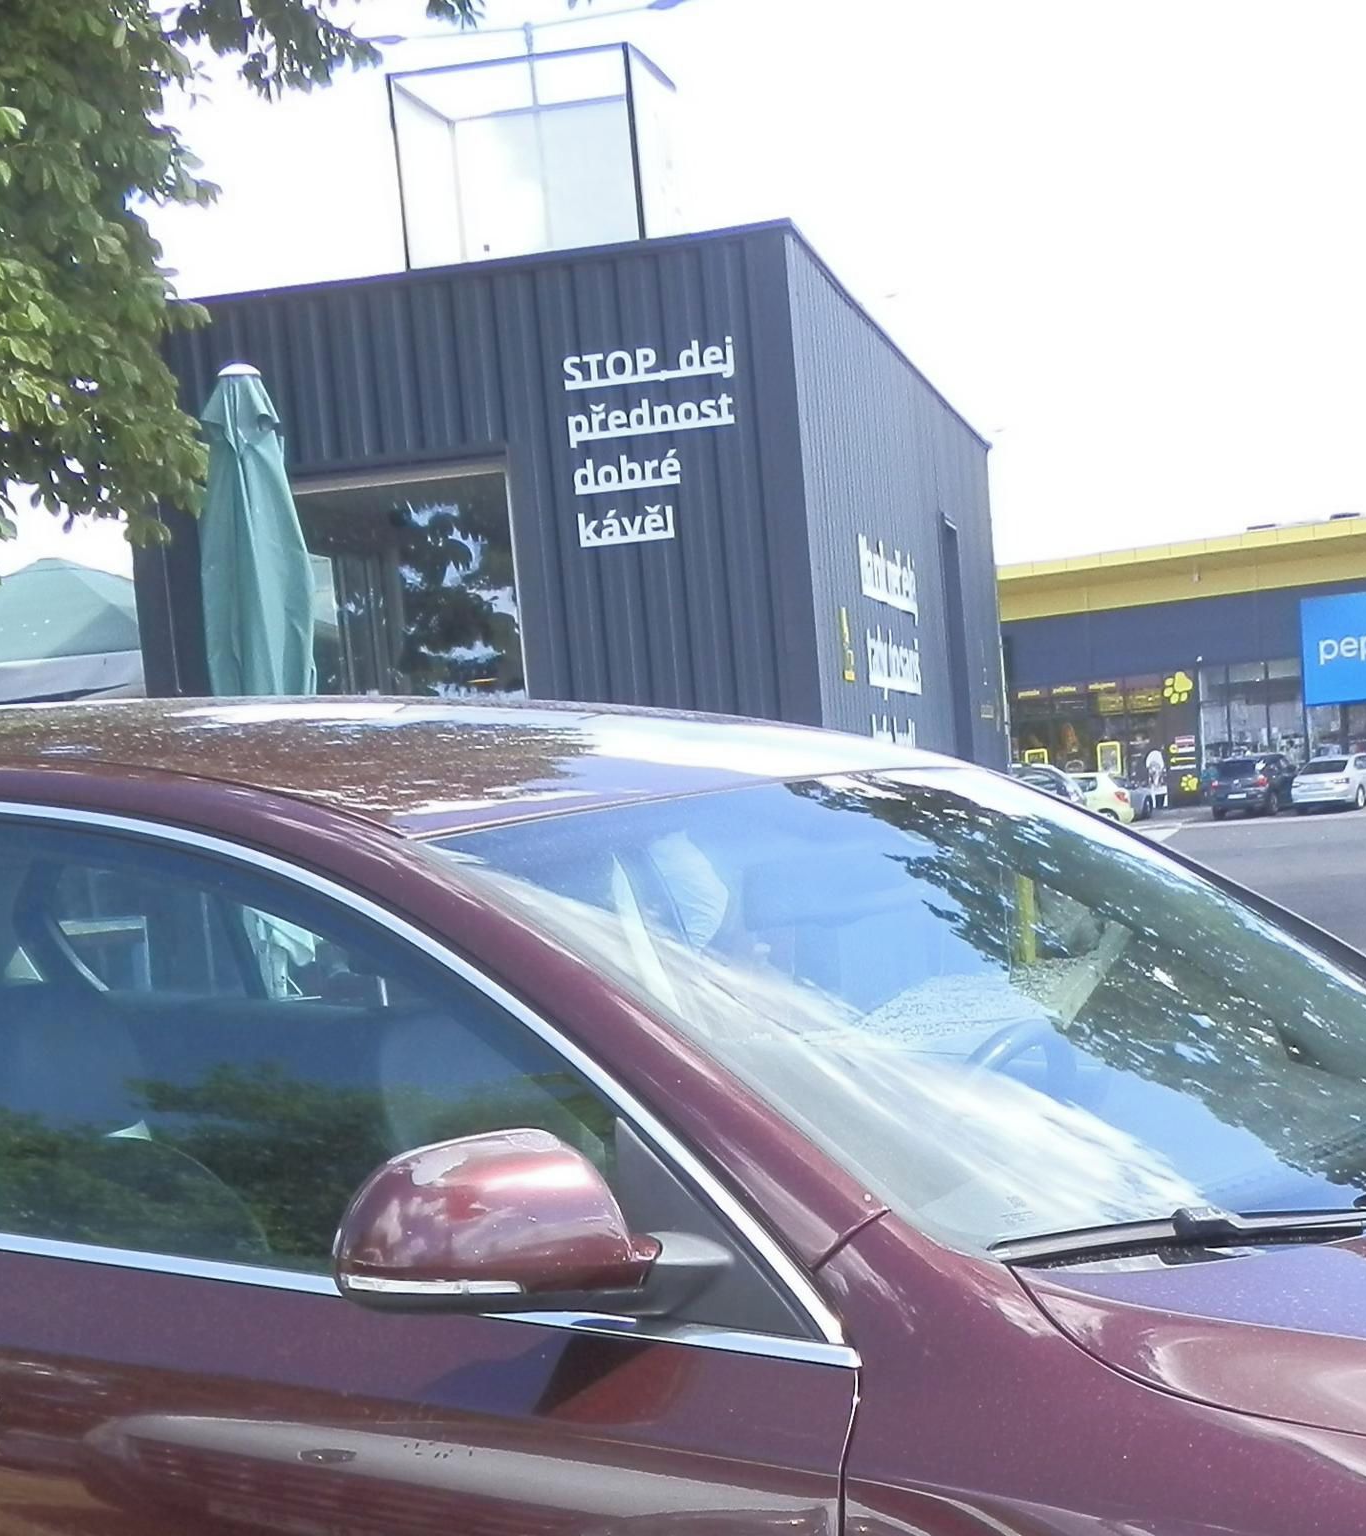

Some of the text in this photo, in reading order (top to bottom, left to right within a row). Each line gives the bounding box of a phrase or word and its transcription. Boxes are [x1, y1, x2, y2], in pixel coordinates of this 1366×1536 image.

[679, 335, 735, 378] dej
[567, 393, 735, 448] přednost
[573, 448, 681, 495] dobré
